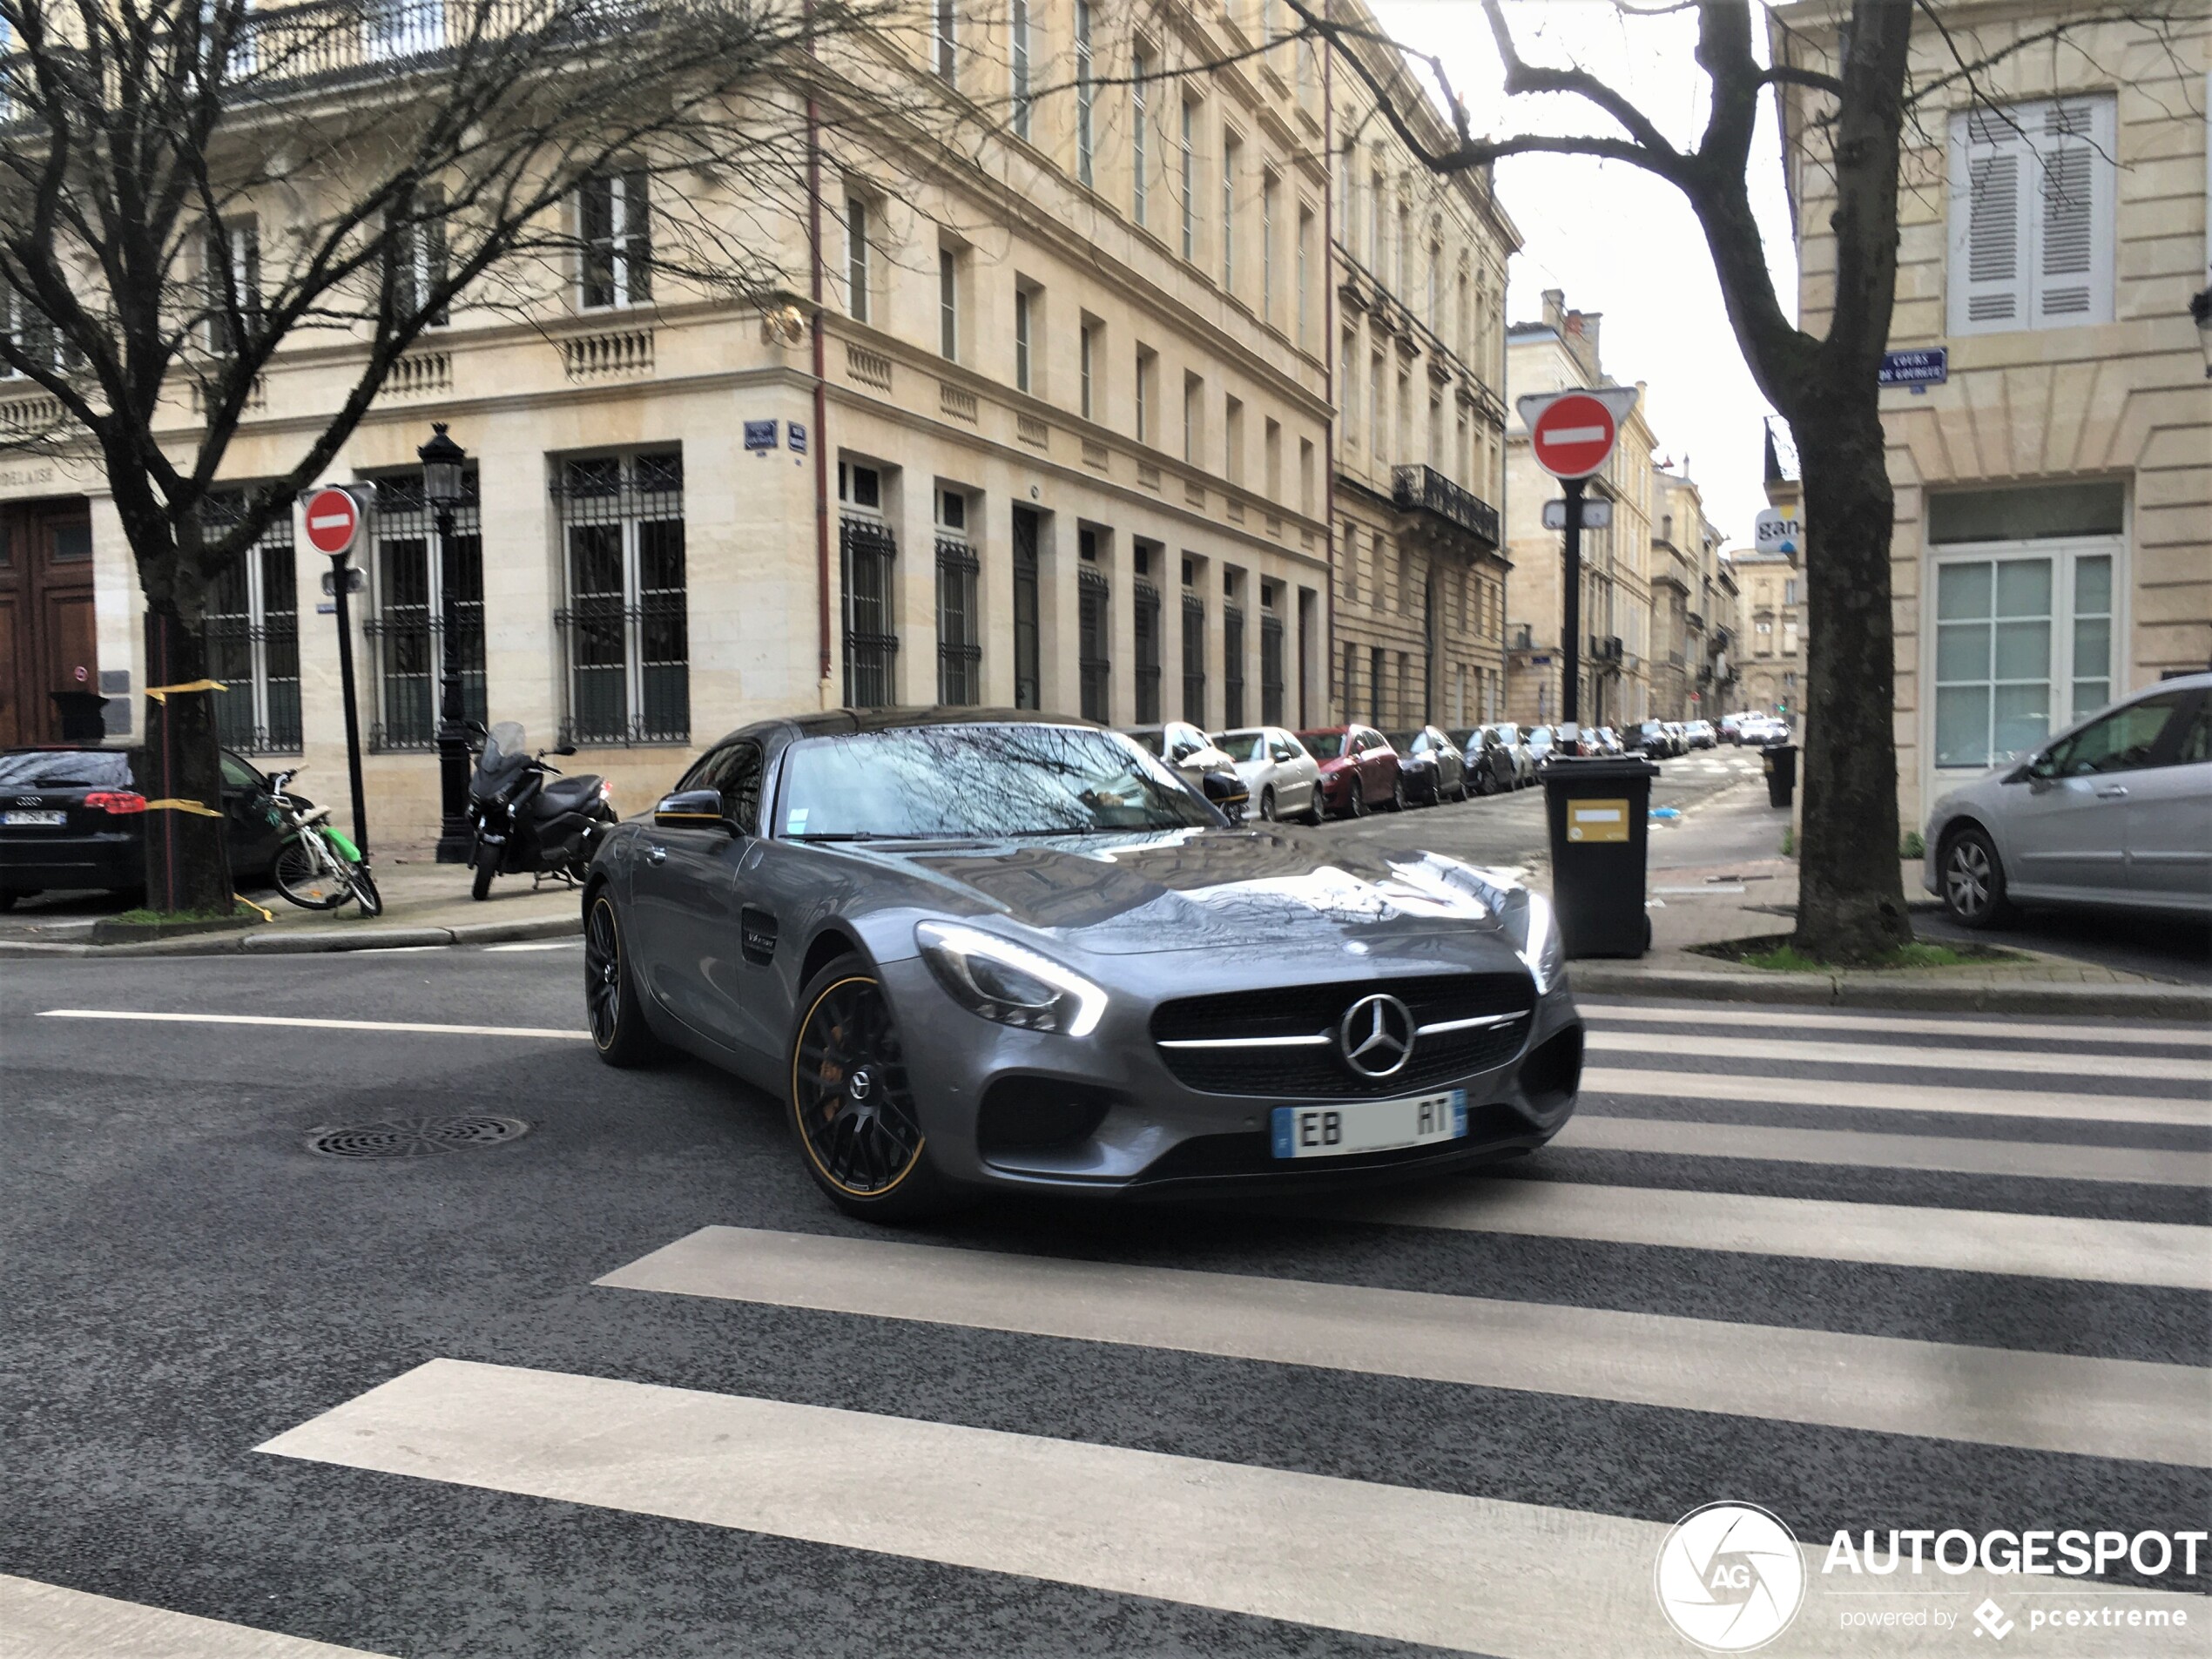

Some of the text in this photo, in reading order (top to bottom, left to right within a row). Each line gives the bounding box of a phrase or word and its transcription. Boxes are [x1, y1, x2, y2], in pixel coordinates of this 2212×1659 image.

[1892, 353, 1929, 367] COURS
[1758, 520, 1798, 541] gan
[1300, 1111, 1340, 1147] EB
